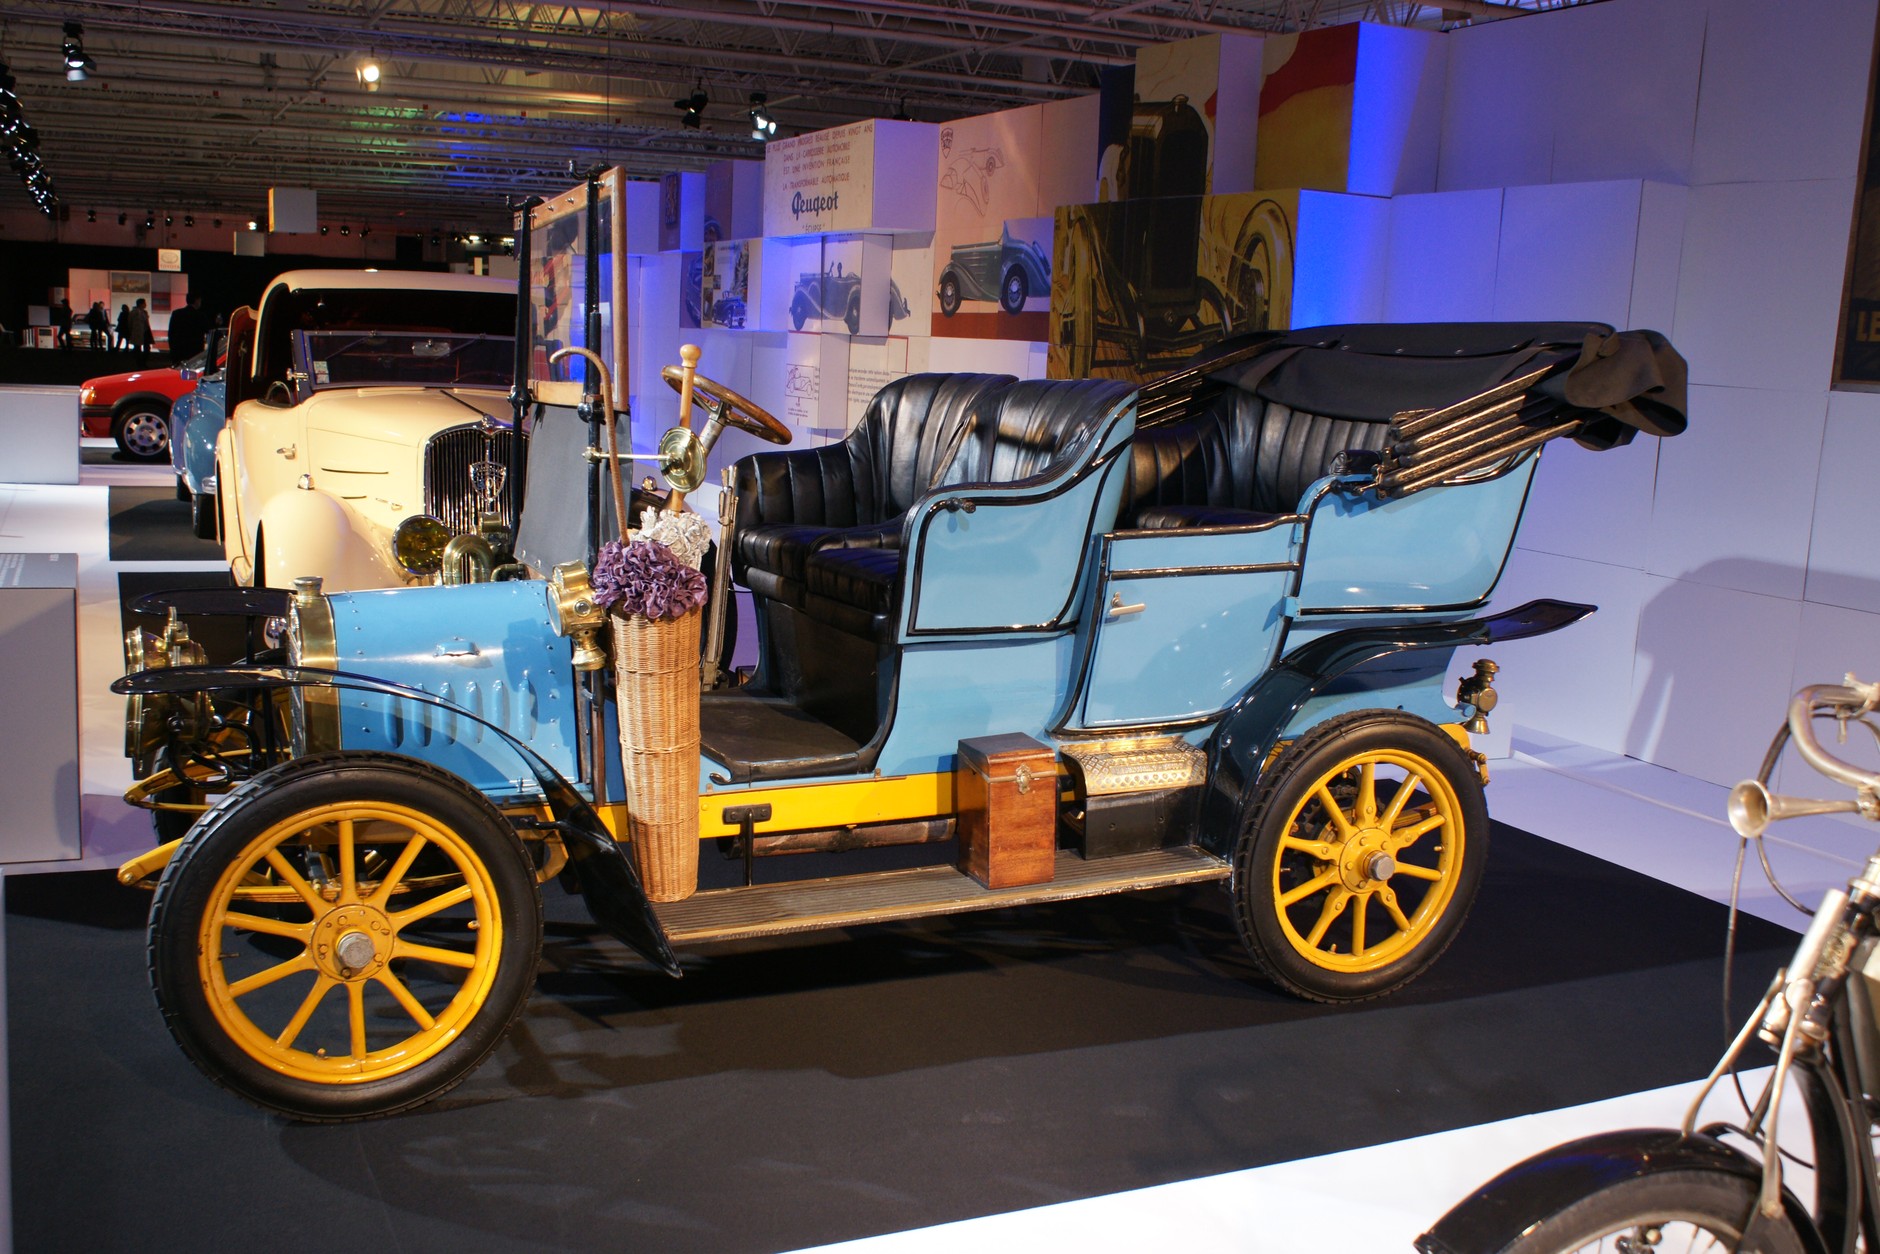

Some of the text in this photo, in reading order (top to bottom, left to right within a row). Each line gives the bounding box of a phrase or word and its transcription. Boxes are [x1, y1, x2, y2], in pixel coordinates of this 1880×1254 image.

[864, 123, 873, 133] ANS
[783, 153, 794, 163] DANS
[827, 142, 850, 153] AUTOMOBILE
[802, 160, 825, 171] INVENTION
[826, 155, 850, 166] FRANÇAISE
[822, 172, 849, 183] AUTOMATIQUE
[792, 191, 838, 220] Peugeot
